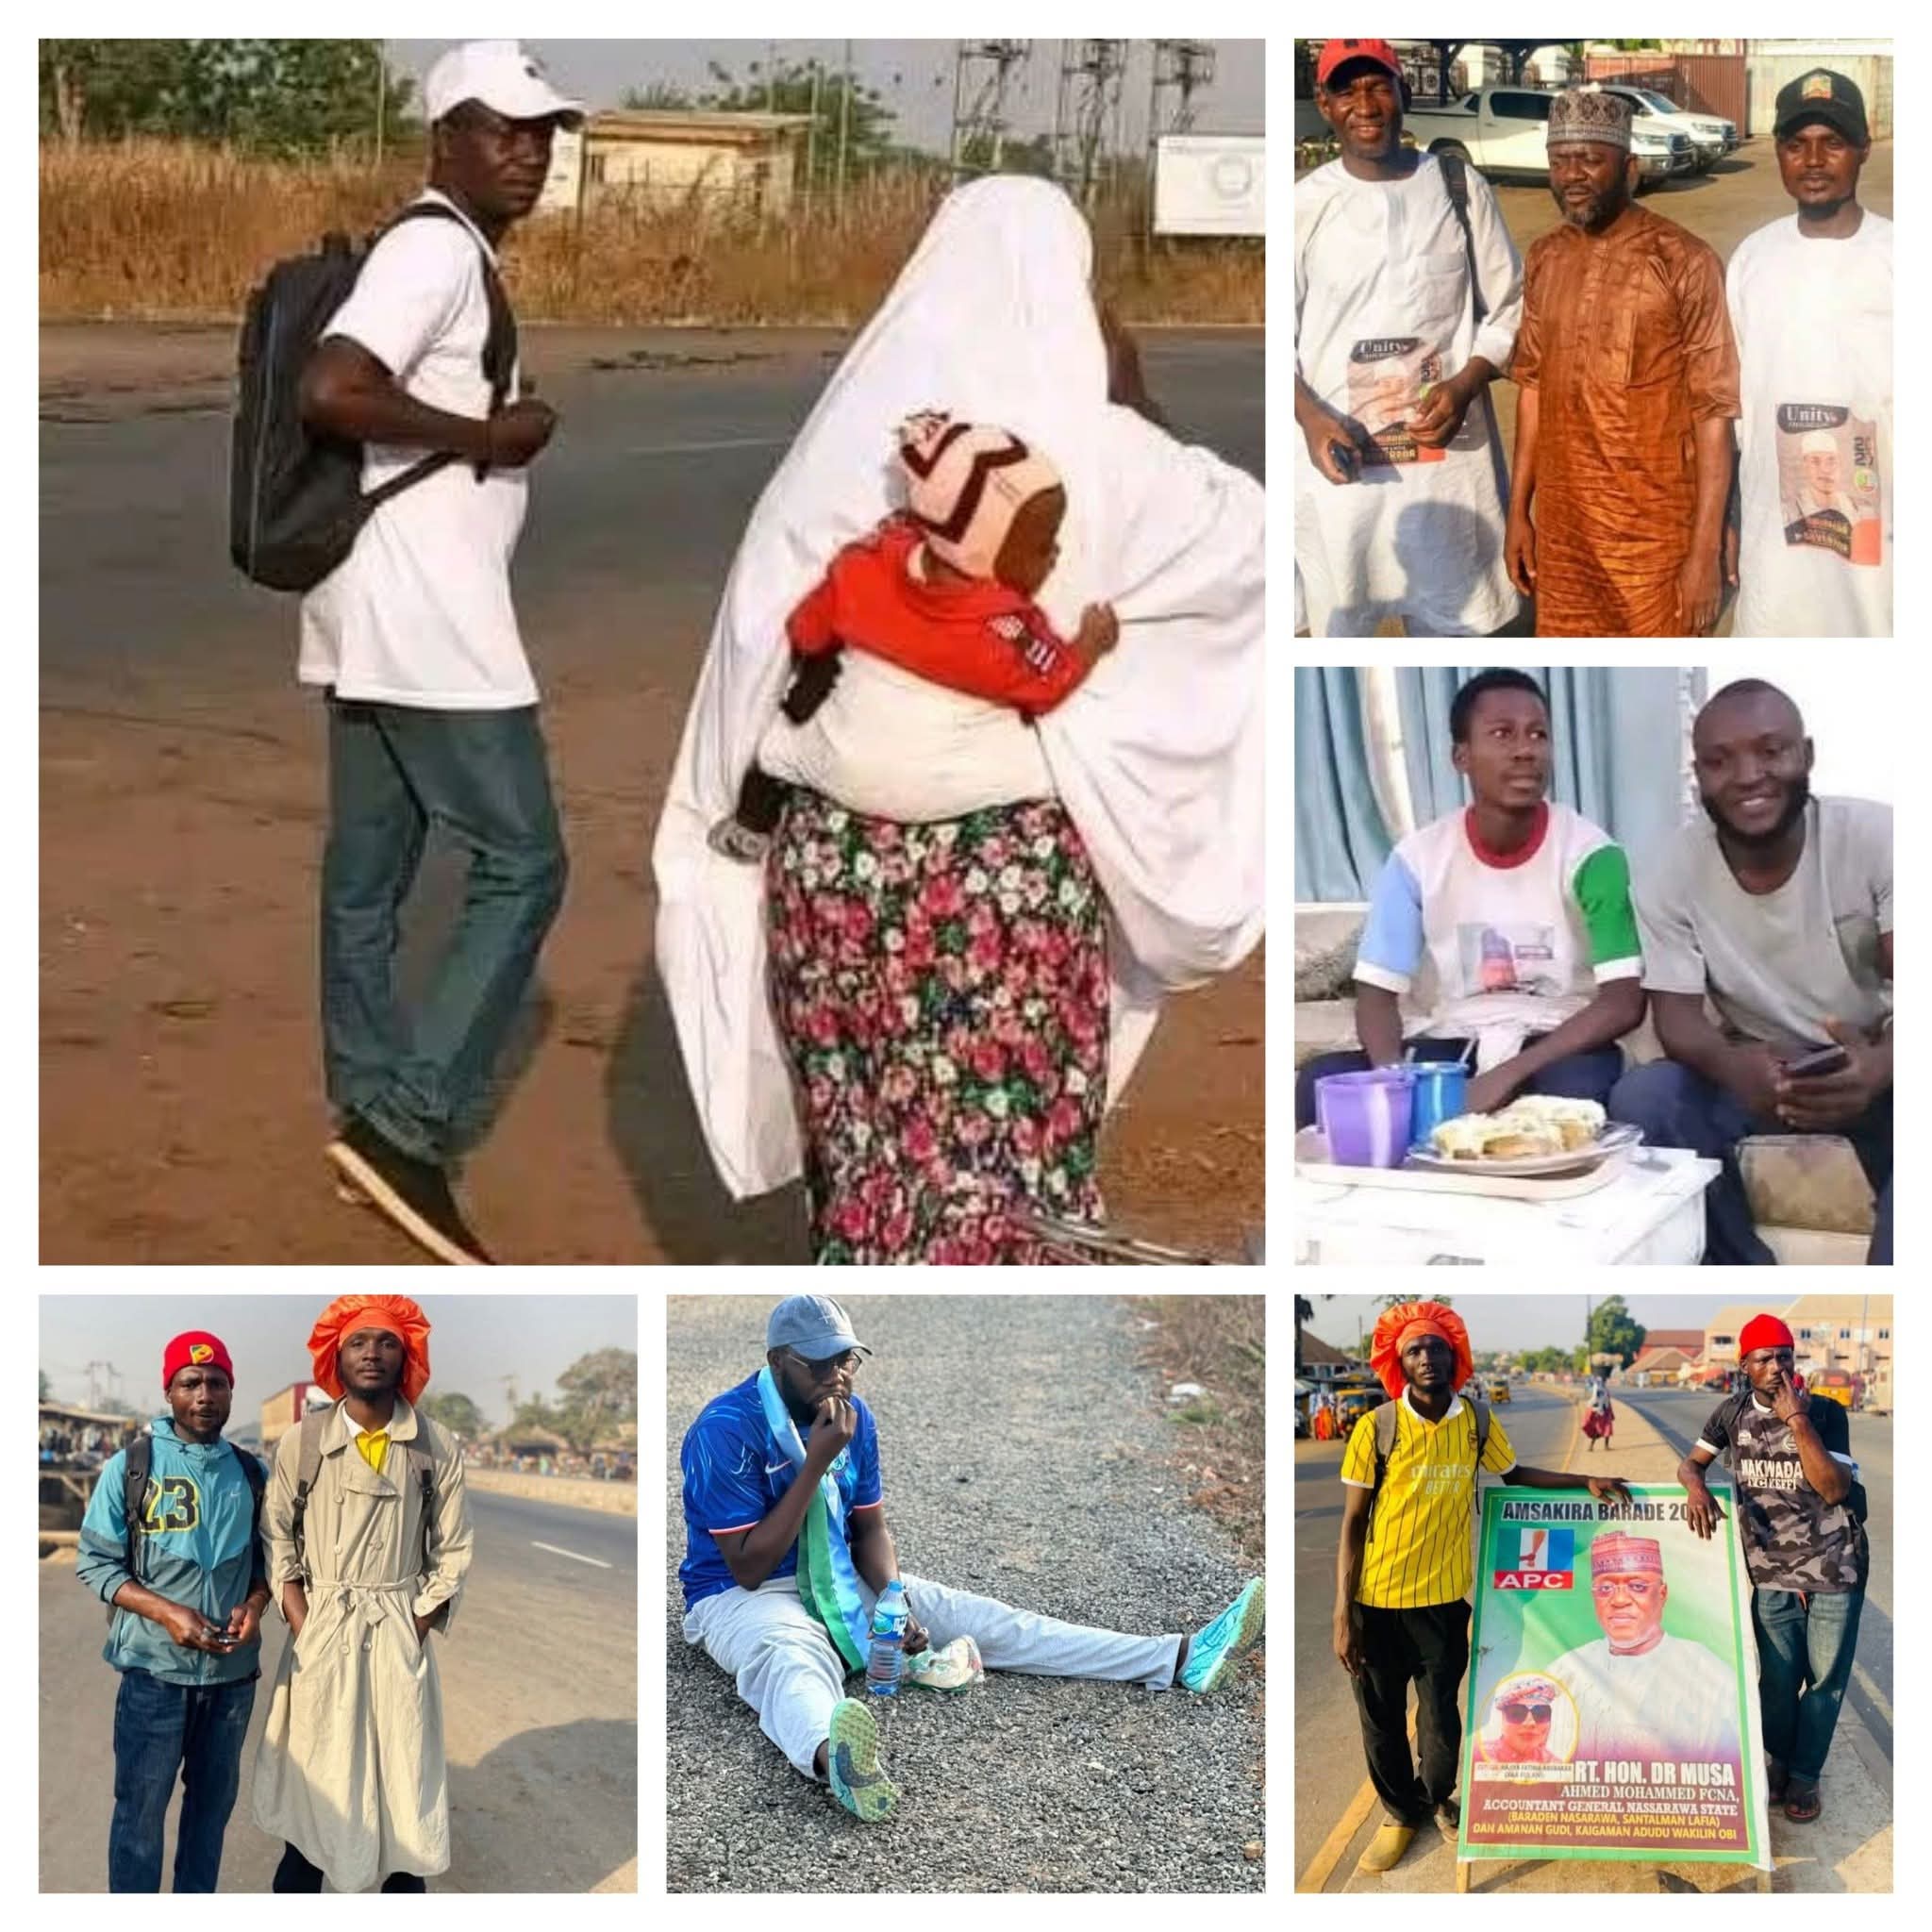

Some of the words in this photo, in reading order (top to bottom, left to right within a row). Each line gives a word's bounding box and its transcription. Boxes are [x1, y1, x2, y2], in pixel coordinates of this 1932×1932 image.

[139, 1475, 201, 1533] 23
[1503, 1502, 1593, 1521] AMSAKIRA
[1598, 1503, 1665, 1522] BARADE
[1498, 1573, 1564, 1589] APC
[1574, 1760, 1601, 1783] RT.
[1604, 1760, 1647, 1784] HON.
[1651, 1761, 1676, 1785] DR
[1680, 1763, 1736, 1787] MUSA
[1560, 1785, 1610, 1798] AHMED
[1613, 1786, 1696, 1800] MOHAMMED
[1699, 1789, 1740, 1803] FCNA,
[1483, 1799, 1565, 1811] ACCOUNTANT
[1568, 1800, 1624, 1813] GENERAL
[1626, 1802, 1698, 1814] NASSARAWA
[1700, 1804, 1739, 1816] STATE
[1623, 1814, 1686, 1825] SANTALMAN
[1473, 1823, 1494, 1833] DAN
[1497, 1824, 1543, 1835] AMANAN
[1574, 1826, 1631, 1837] KAIGAMAN
[1633, 1826, 1670, 1838] ADUDU
[1673, 1828, 1716, 1839] WAKILIN
[1719, 1829, 1737, 1840] OBI
